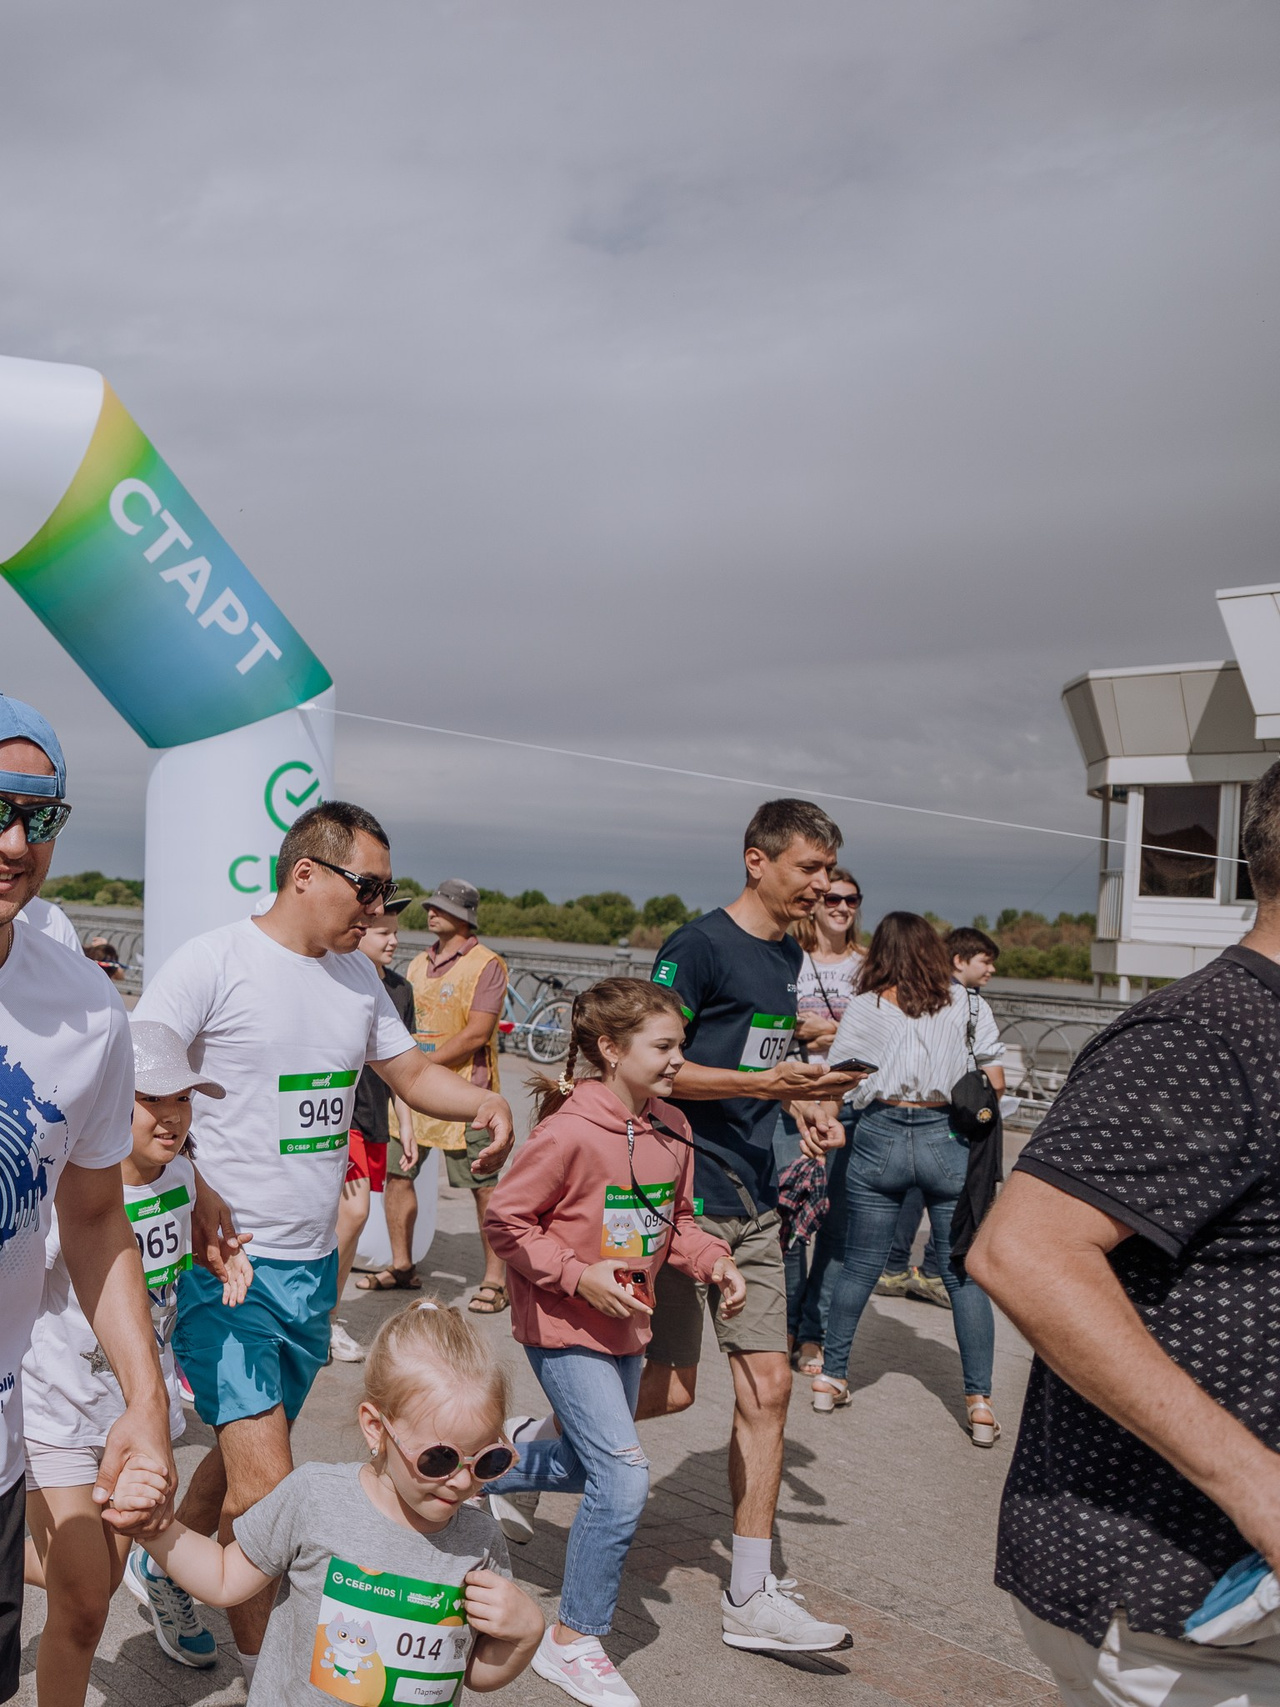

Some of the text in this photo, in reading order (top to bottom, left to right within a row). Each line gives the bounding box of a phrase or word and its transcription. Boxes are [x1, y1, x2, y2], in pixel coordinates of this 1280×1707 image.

[109, 477, 283, 676] СТАРТ
[759, 1037, 786, 1060] 075
[298, 1097, 344, 1128] 949
[345, 1577, 396, 1598] СБЕР KIDS
[396, 1632, 443, 1661] 014
